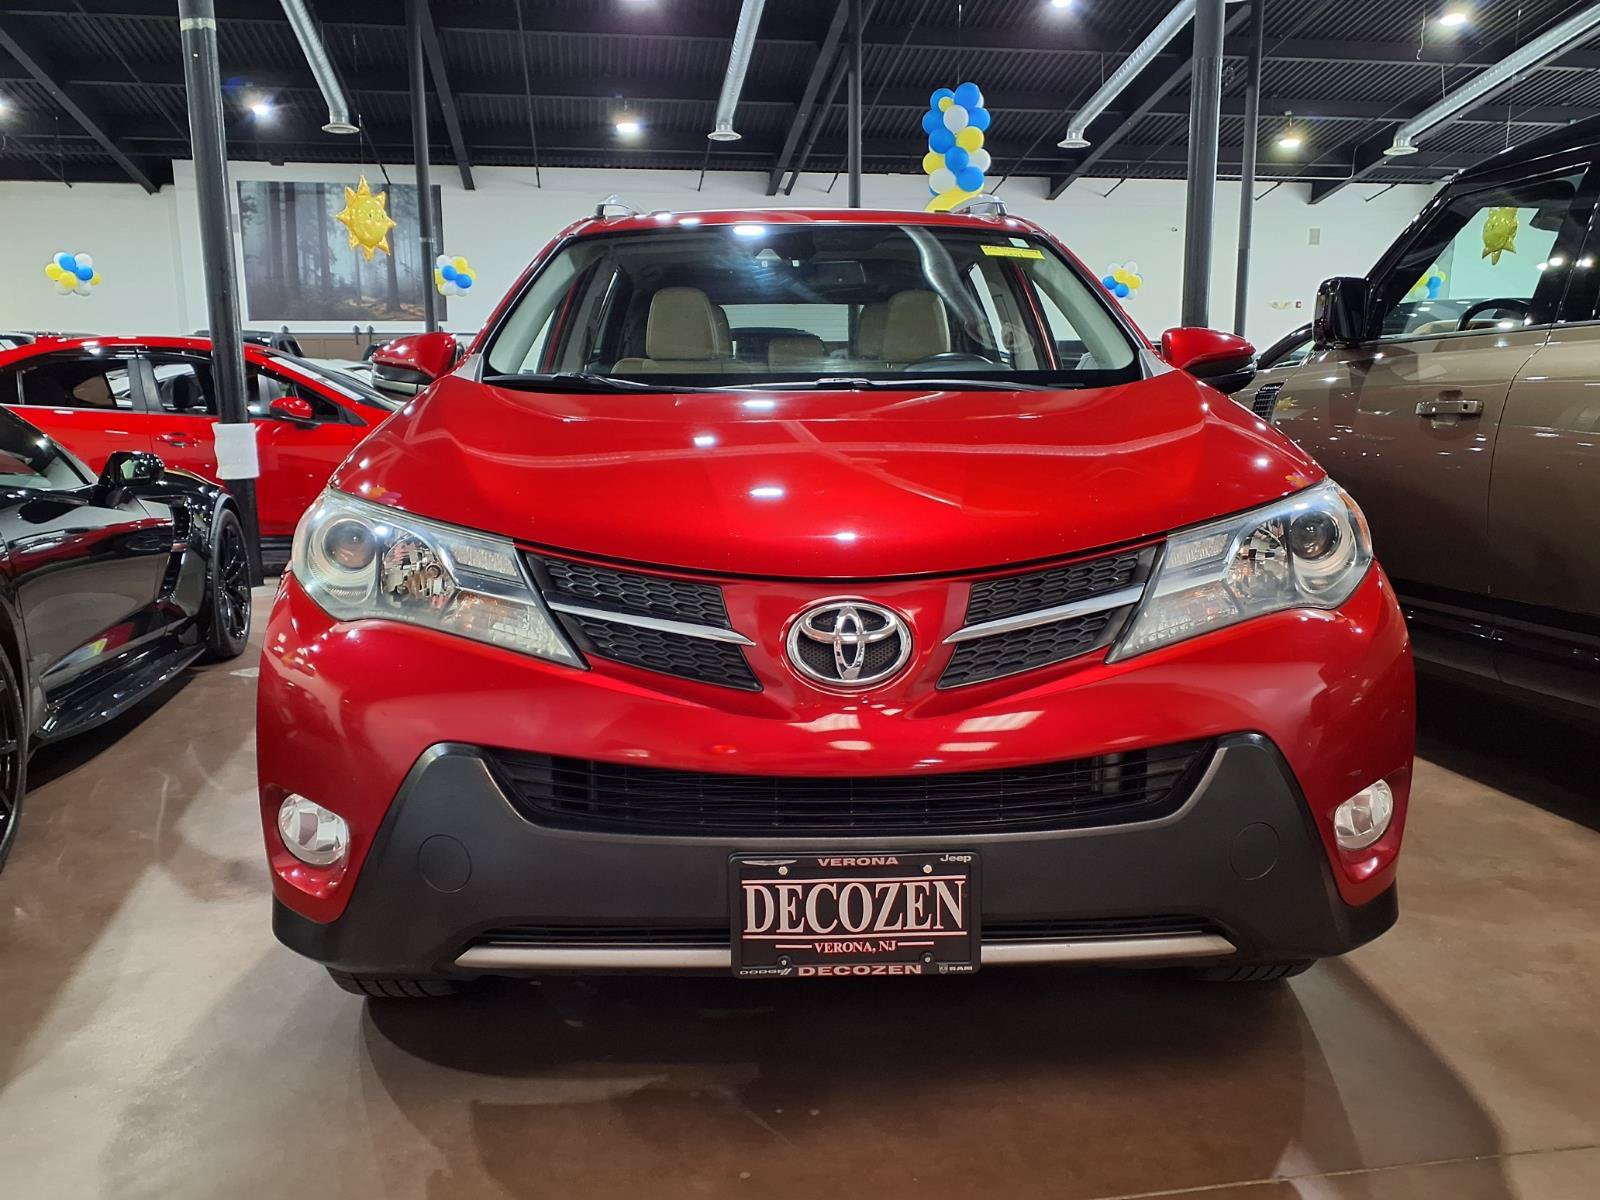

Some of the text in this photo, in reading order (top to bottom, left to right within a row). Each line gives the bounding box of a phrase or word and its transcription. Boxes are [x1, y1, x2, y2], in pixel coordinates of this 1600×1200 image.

[817, 857, 899, 867] VERONA
[940, 854, 972, 863] Jeep
[742, 880, 966, 934] DECOZEN
[813, 940, 897, 953] VERONA, NJ
[798, 964, 921, 976] DECOZEN
